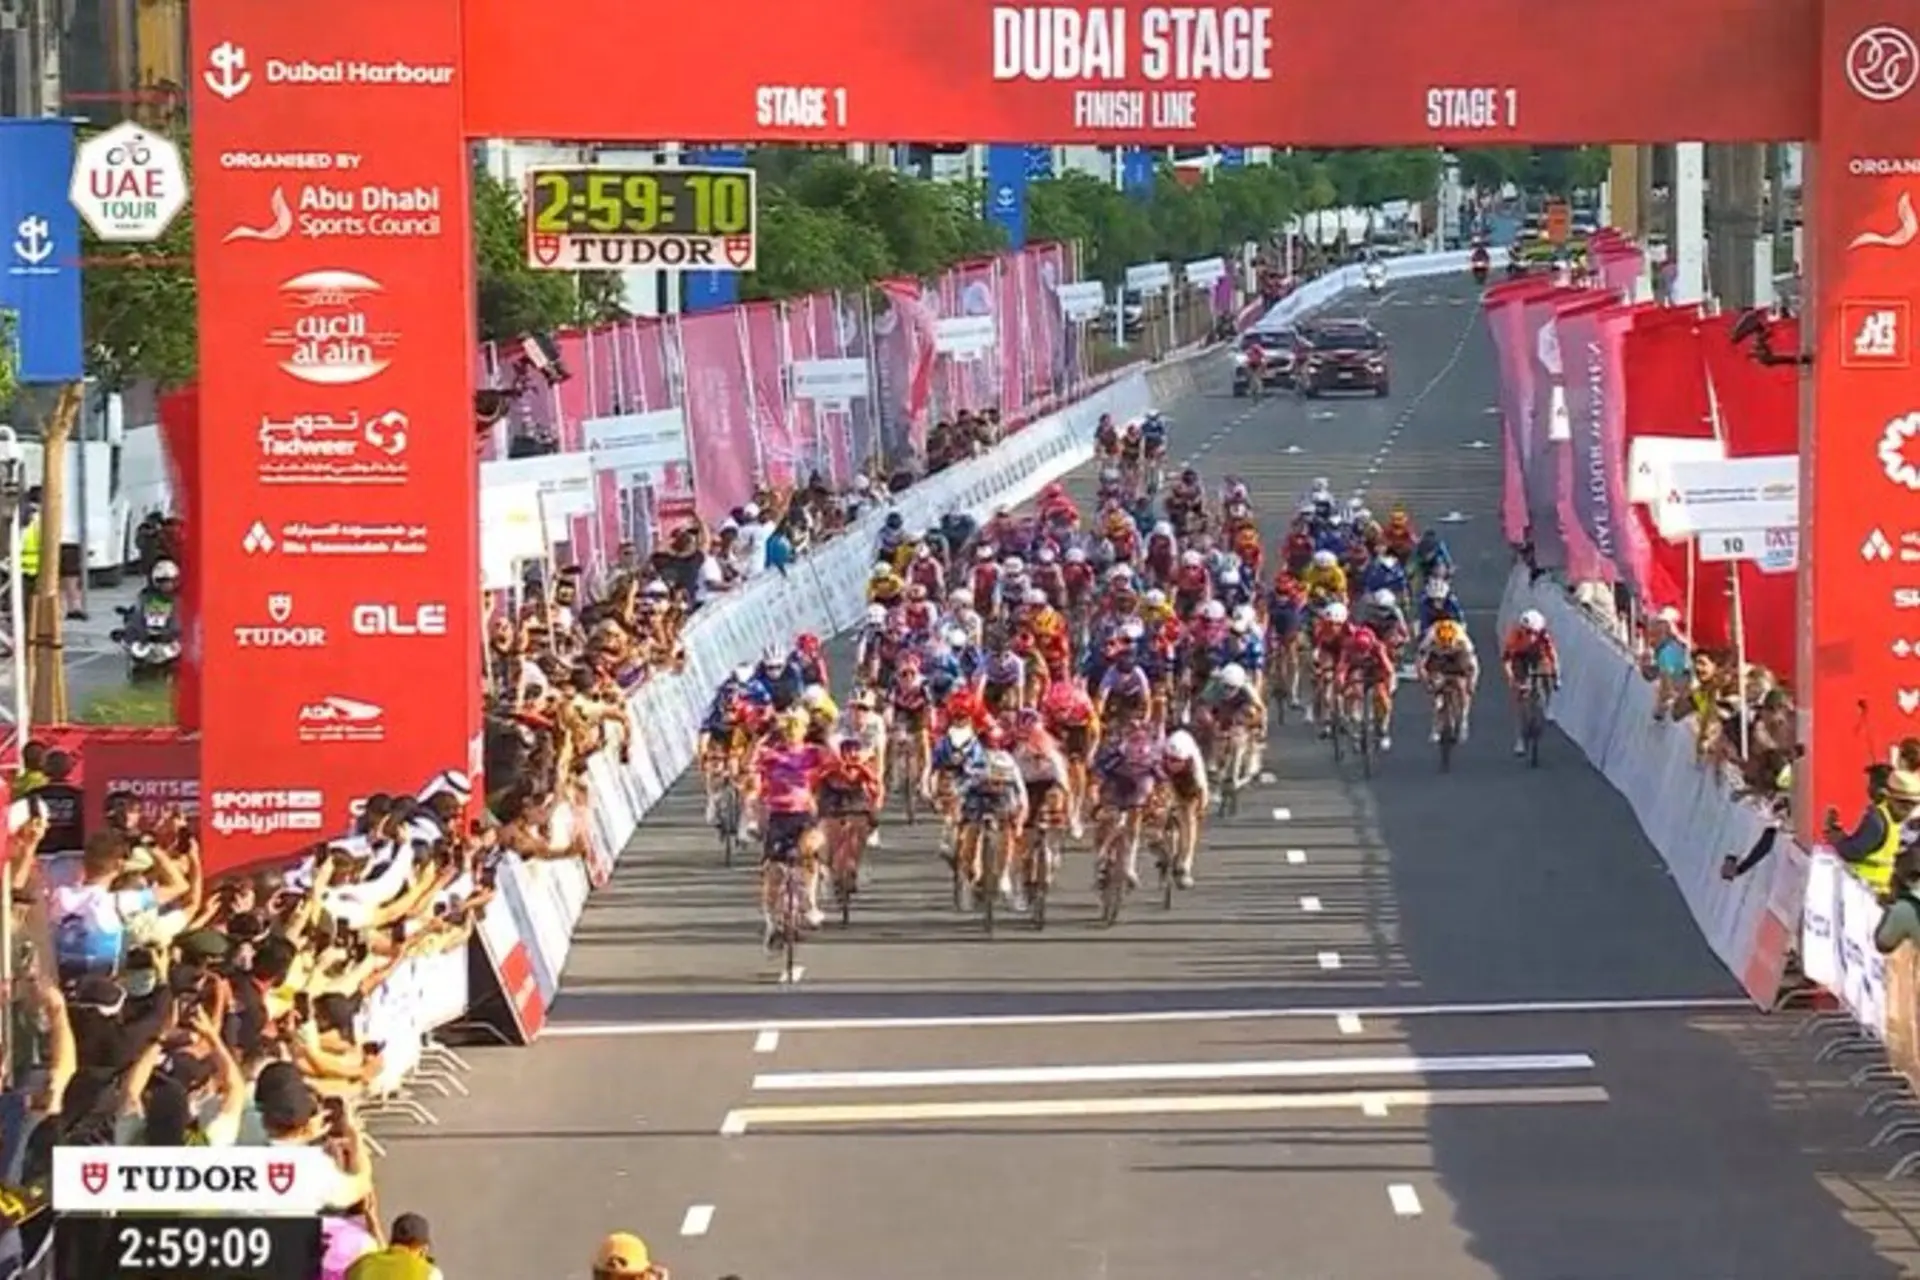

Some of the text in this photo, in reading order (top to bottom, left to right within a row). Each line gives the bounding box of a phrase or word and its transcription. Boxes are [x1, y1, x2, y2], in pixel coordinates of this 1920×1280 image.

[993, 8, 1273, 80] DUBAI STAGE
[266, 60, 454, 83] Dubai Harbour
[756, 86, 847, 126] STAGE 1
[1074, 91, 1196, 127] FINISH LINE
[1427, 88, 1516, 127] STAGE 1
[220, 153, 362, 168] ORGANISED BY
[89, 168, 165, 199] UAE
[101, 201, 157, 219] TOUR
[301, 187, 439, 211] Abu Dhabi
[300, 213, 441, 238] Sports Council
[571, 238, 715, 264] TUDOR
[293, 338, 373, 365] al ain
[1723, 537, 1744, 553] 10
[235, 628, 325, 645] TUDOR
[212, 791, 287, 808] SPORTS
